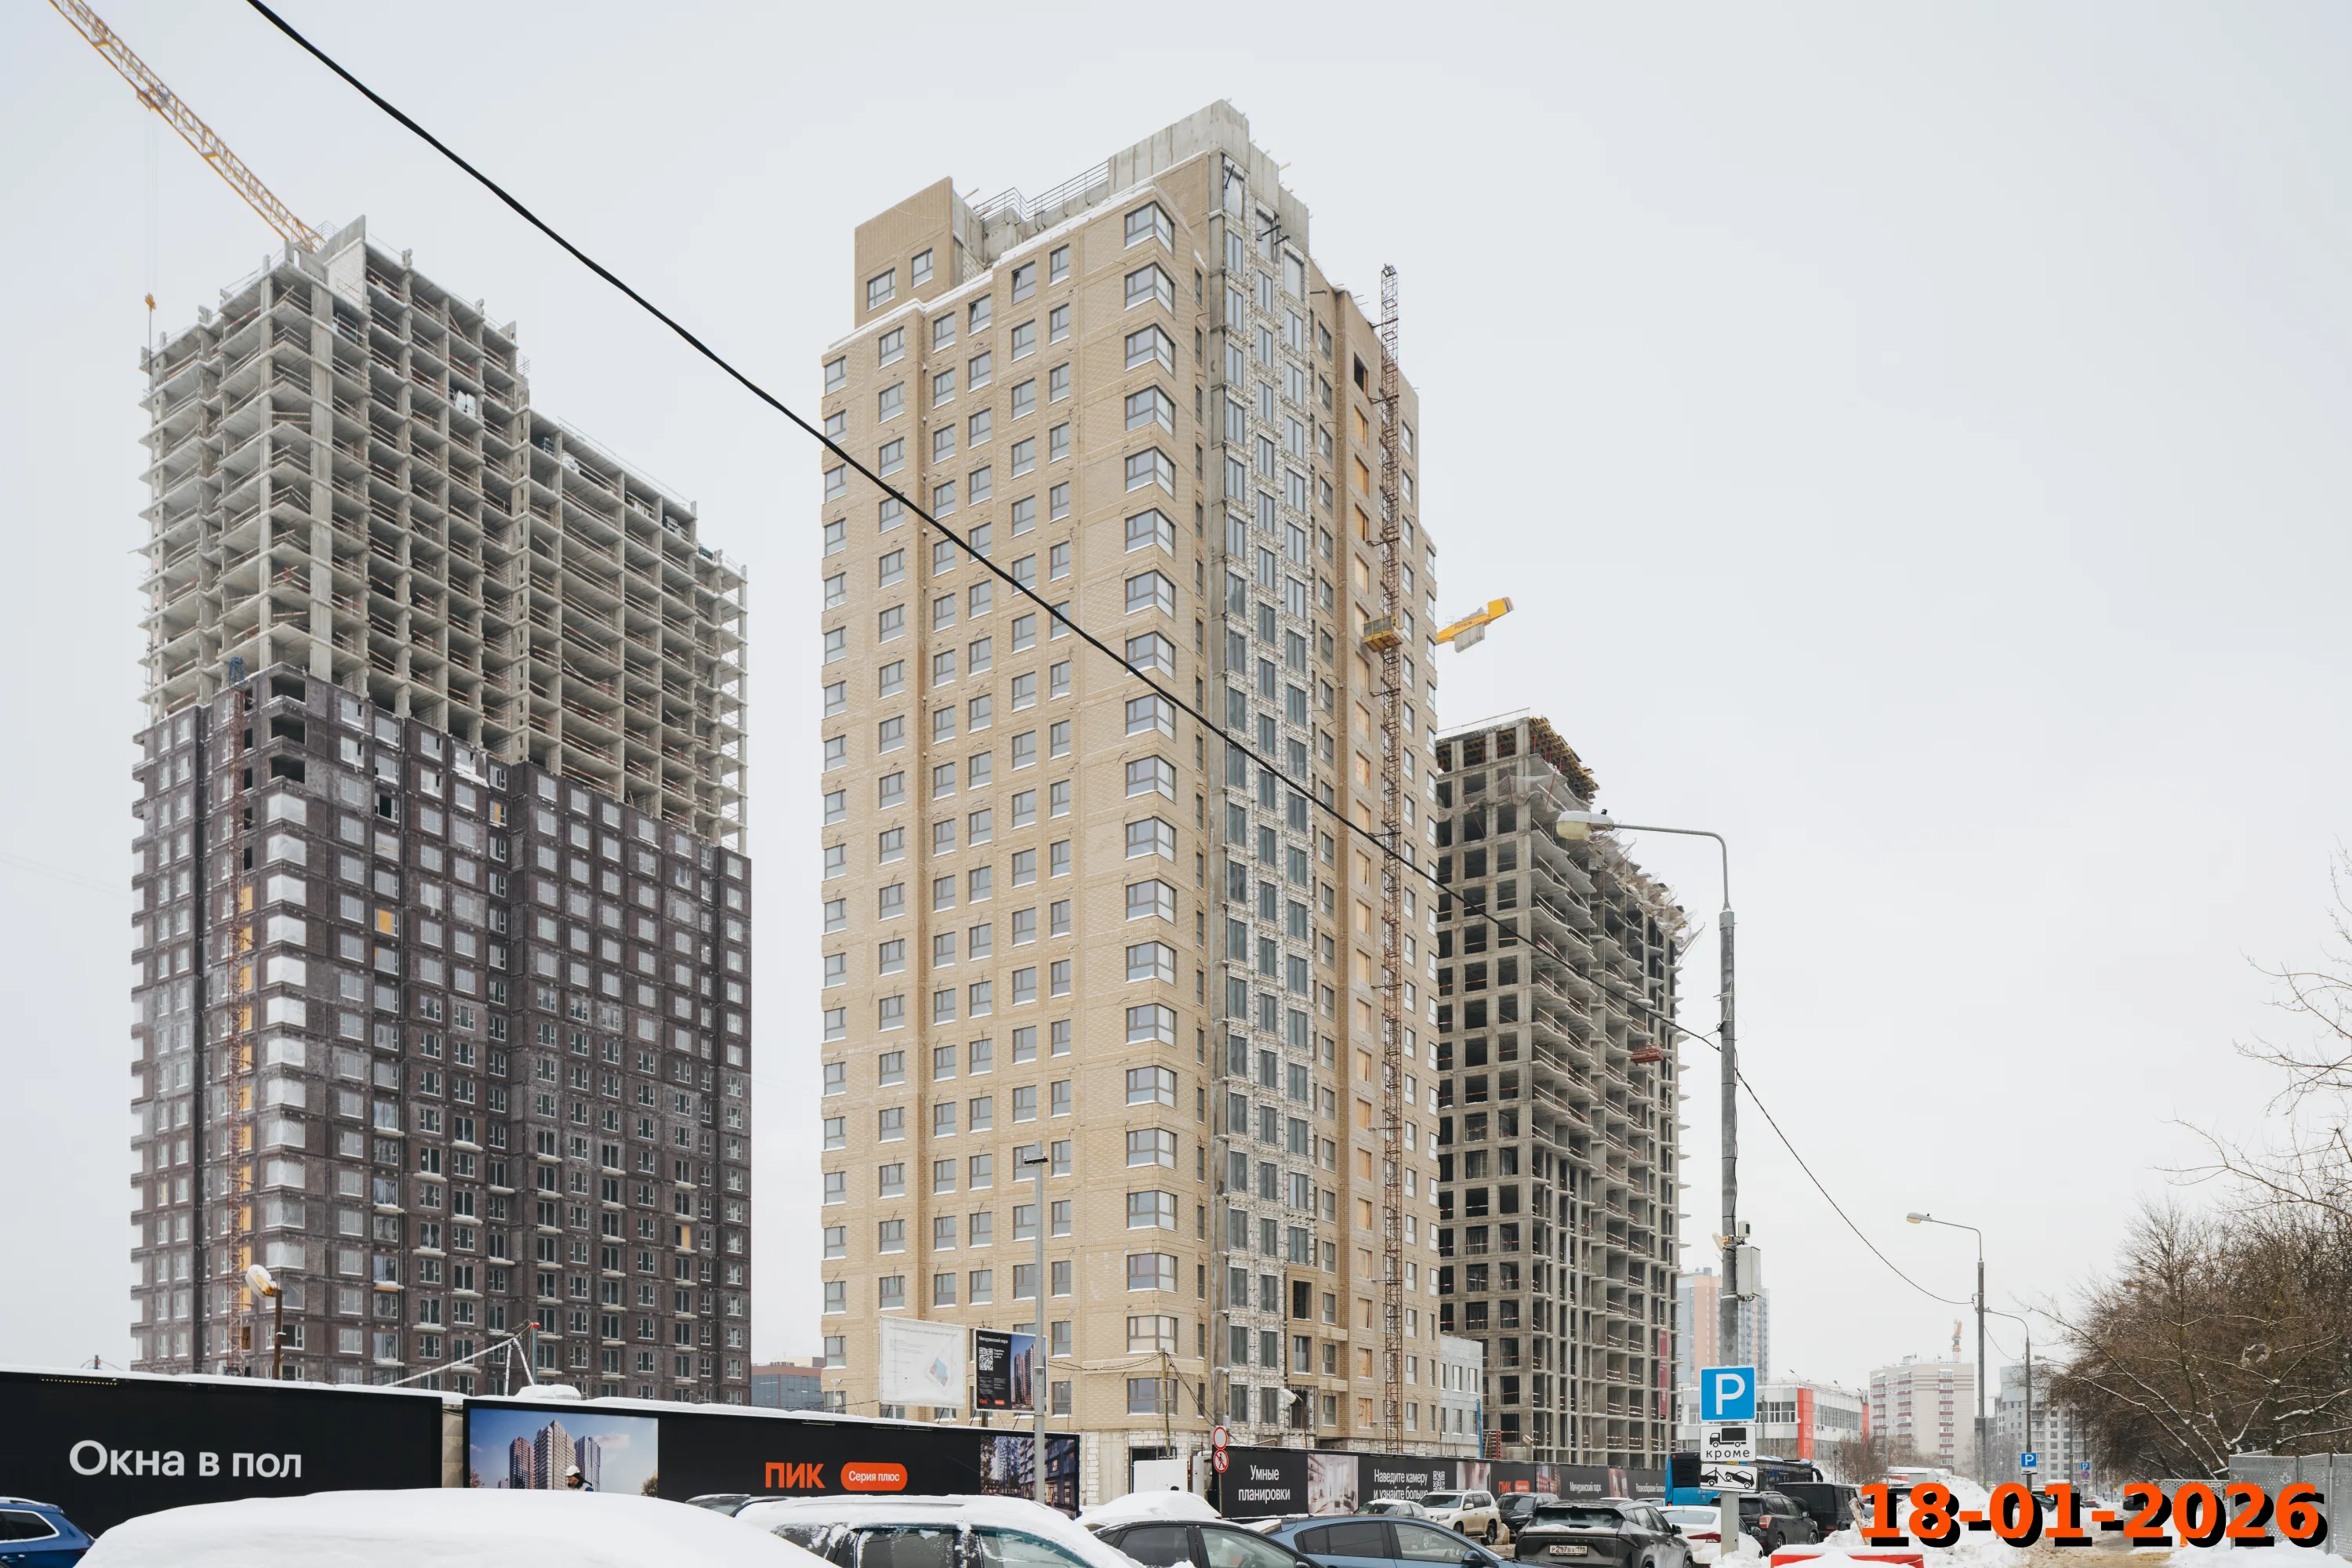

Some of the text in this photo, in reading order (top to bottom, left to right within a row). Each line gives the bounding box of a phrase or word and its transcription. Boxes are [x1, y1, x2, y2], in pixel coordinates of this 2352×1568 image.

[1454, 620, 1472, 630] POTAIN
[1715, 1373, 1746, 1415] P
[69, 1439, 302, 1478] Окна в пол
[1705, 1449, 1751, 1461] кроме
[2024, 1454, 2034, 1466] P
[765, 1462, 826, 1489] ПИК
[848, 1470, 900, 1483] Серия плюс
[1250, 1465, 1279, 1481] Умные
[1374, 1468, 1428, 1486] Наведите камеру
[1373, 1489, 1378, 1500] и
[1379, 1486, 1405, 1500] узнайте
[1498, 1480, 1512, 1494] ПИК
[1593, 1483, 1602, 1494] парк
[1238, 1488, 1290, 1504] планировки
